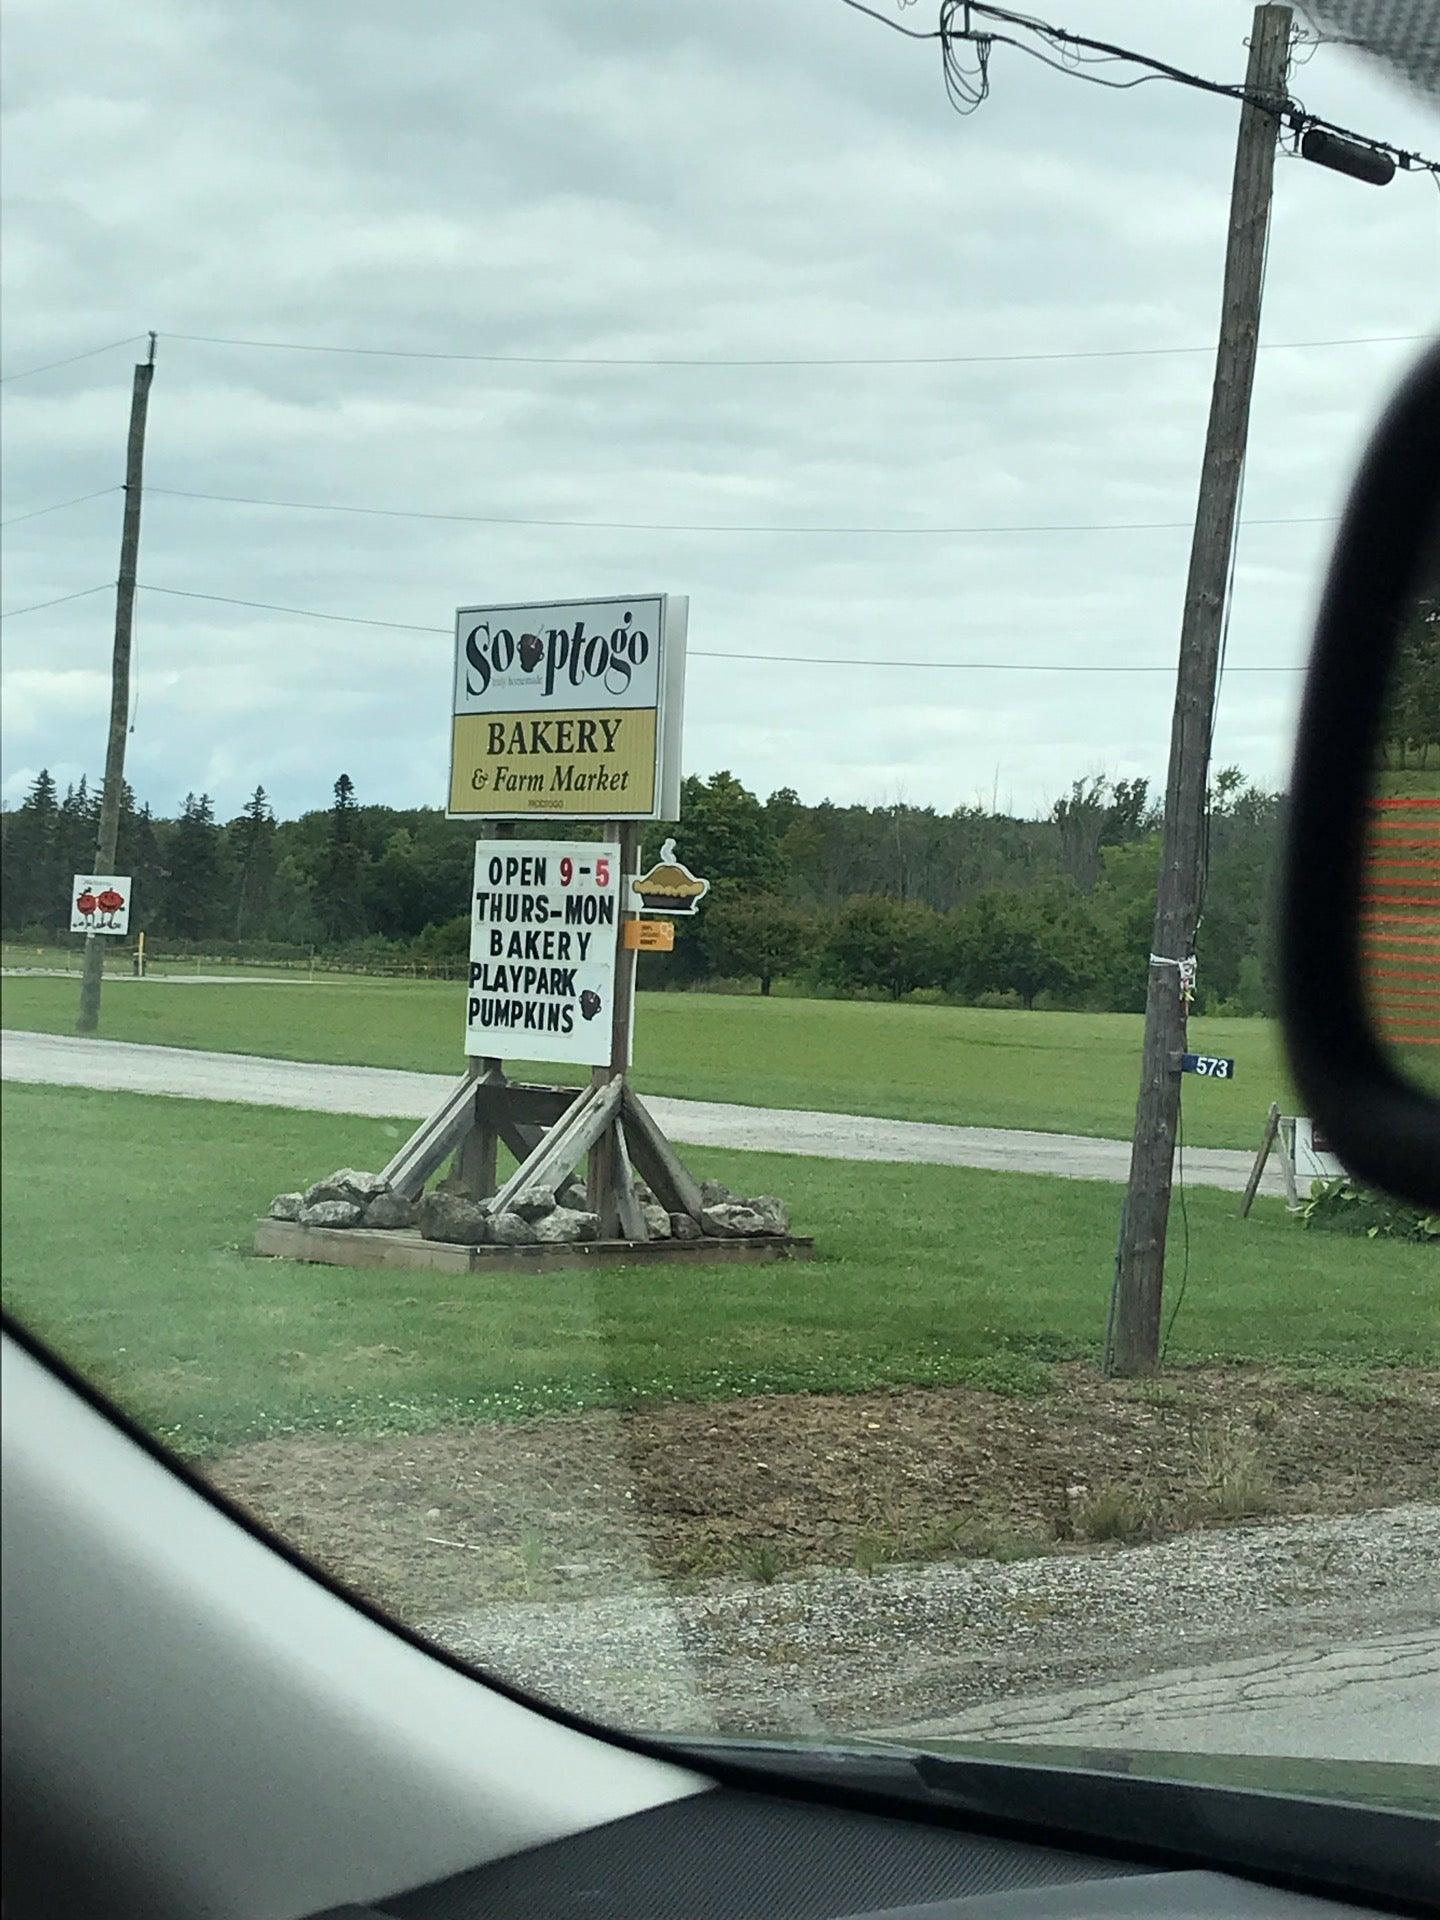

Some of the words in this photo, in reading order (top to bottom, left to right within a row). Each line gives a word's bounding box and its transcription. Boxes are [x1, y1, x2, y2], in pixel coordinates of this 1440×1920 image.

[487, 718, 622, 755] BAKERY
[471, 768, 488, 790] &
[493, 766, 544, 792] Farm
[550, 764, 629, 792] Market
[488, 856, 547, 887] OPEN
[490, 929, 592, 961] BAKERY
[469, 961, 578, 997] PLAYPARK
[468, 997, 574, 1033] PUMPKINS
[1195, 1057, 1228, 1078] 573
